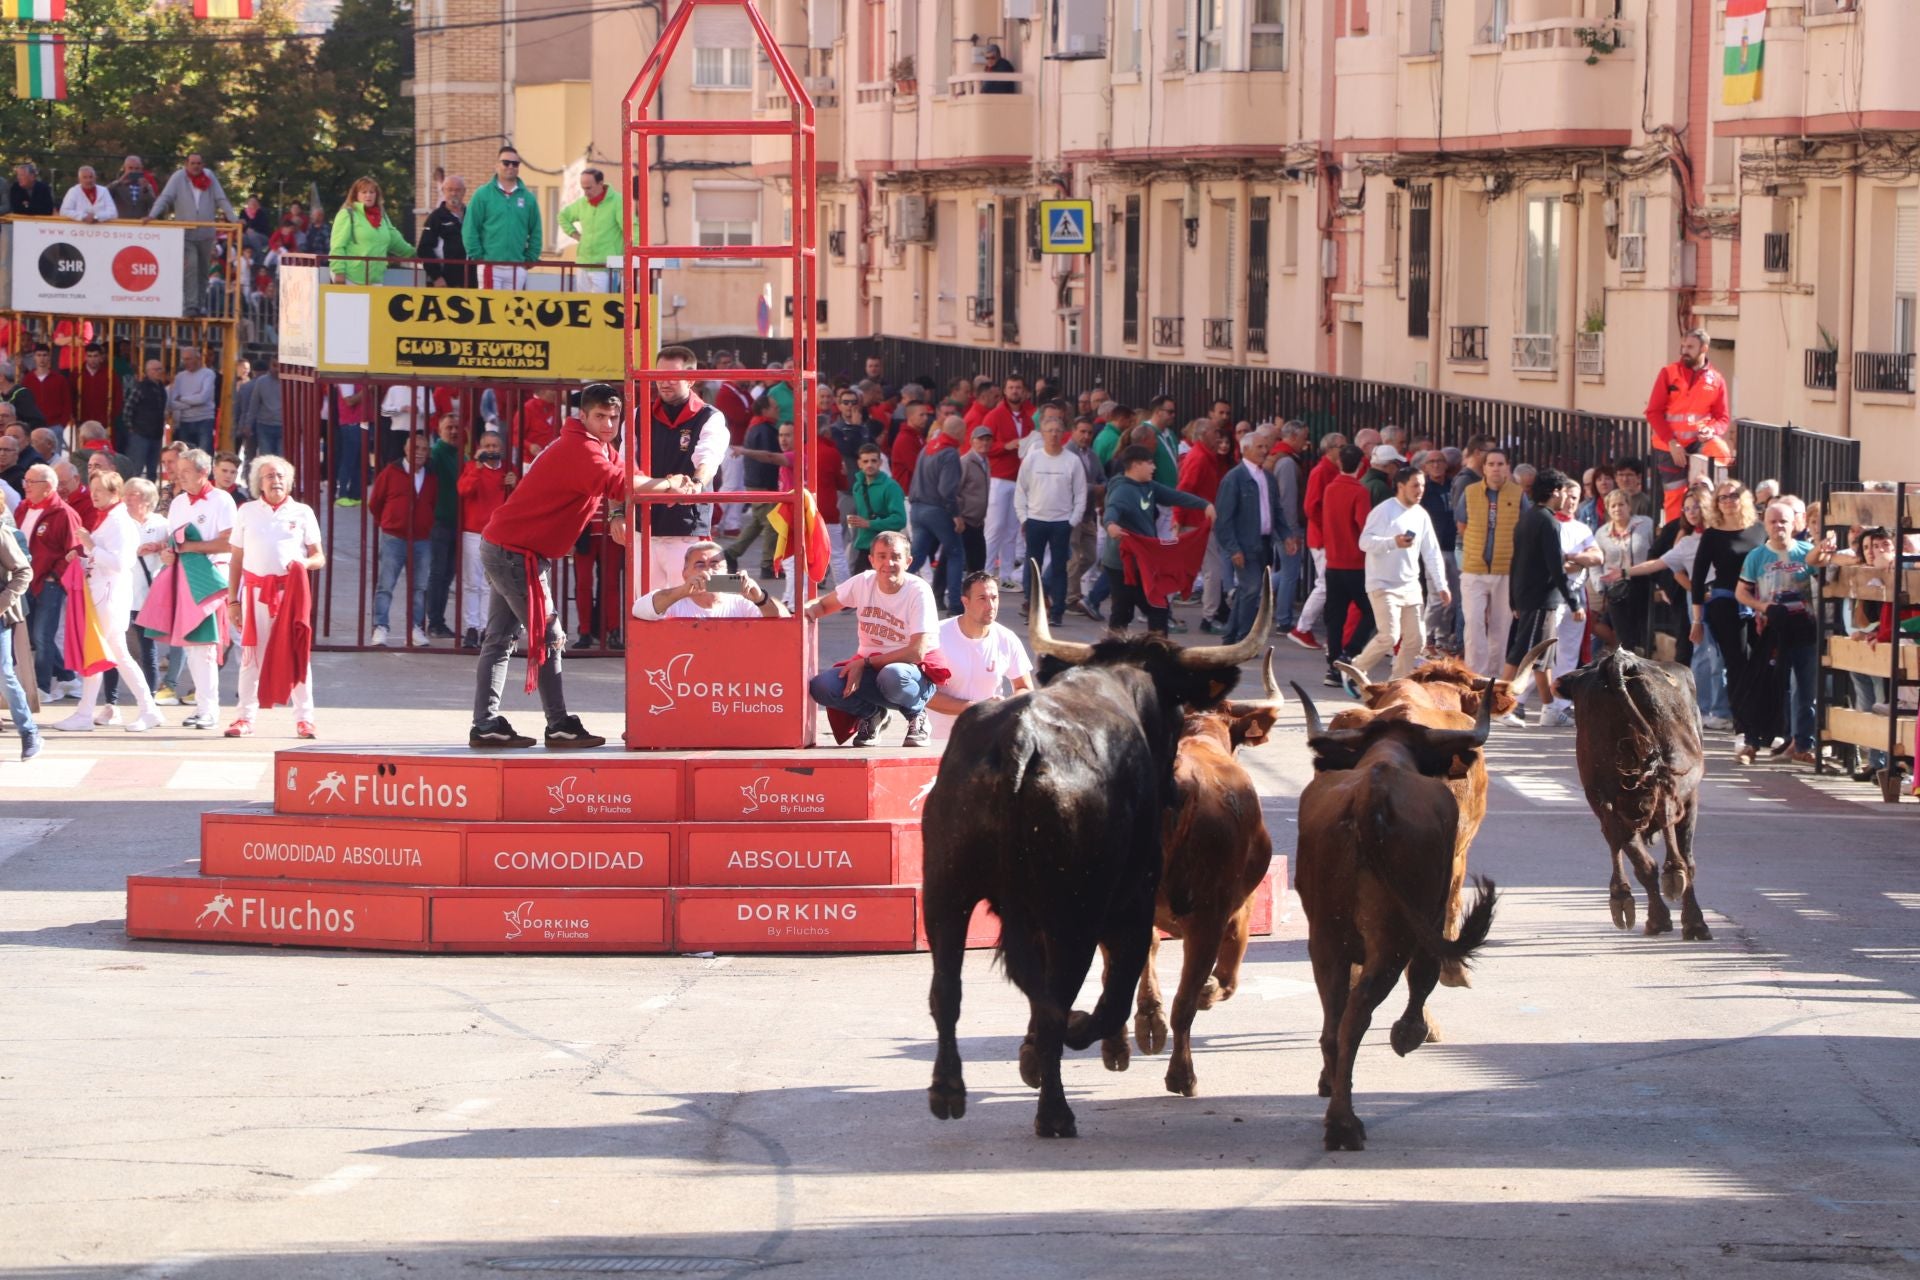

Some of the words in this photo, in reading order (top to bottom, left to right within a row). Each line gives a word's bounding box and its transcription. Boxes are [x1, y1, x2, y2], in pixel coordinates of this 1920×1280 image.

[57, 259, 84, 273] SHR
[131, 263, 158, 276] SHR
[388, 293, 496, 325] CASI
[399, 339, 446, 355] CLUB
[449, 340, 473, 356] DE
[477, 342, 547, 359] FUTBOL
[457, 356, 546, 369] AFICIONADO
[677, 682, 784, 698] DORKING
[712, 701, 729, 715] By
[733, 701, 784, 713] Fluchos
[354, 774, 468, 808] Fluchos
[566, 793, 632, 804] DORKING
[759, 793, 825, 804] DORKING
[587, 805, 599, 814] By
[600, 805, 632, 814] Fluchos
[780, 805, 792, 814] By
[793, 805, 825, 813] Fluchos
[242, 842, 336, 863] COMODIDAD
[342, 847, 422, 867] ABSOLUTA
[494, 851, 644, 870] COMODIDAD
[727, 850, 853, 869] ABSOLUTA
[242, 897, 355, 932] Fluchos
[737, 903, 857, 920] DORKING
[523, 919, 590, 929] DORKING
[767, 926, 781, 936] By
[786, 926, 830, 935] Fluchos
[544, 931, 556, 939] By
[557, 930, 589, 939] Fluchos
